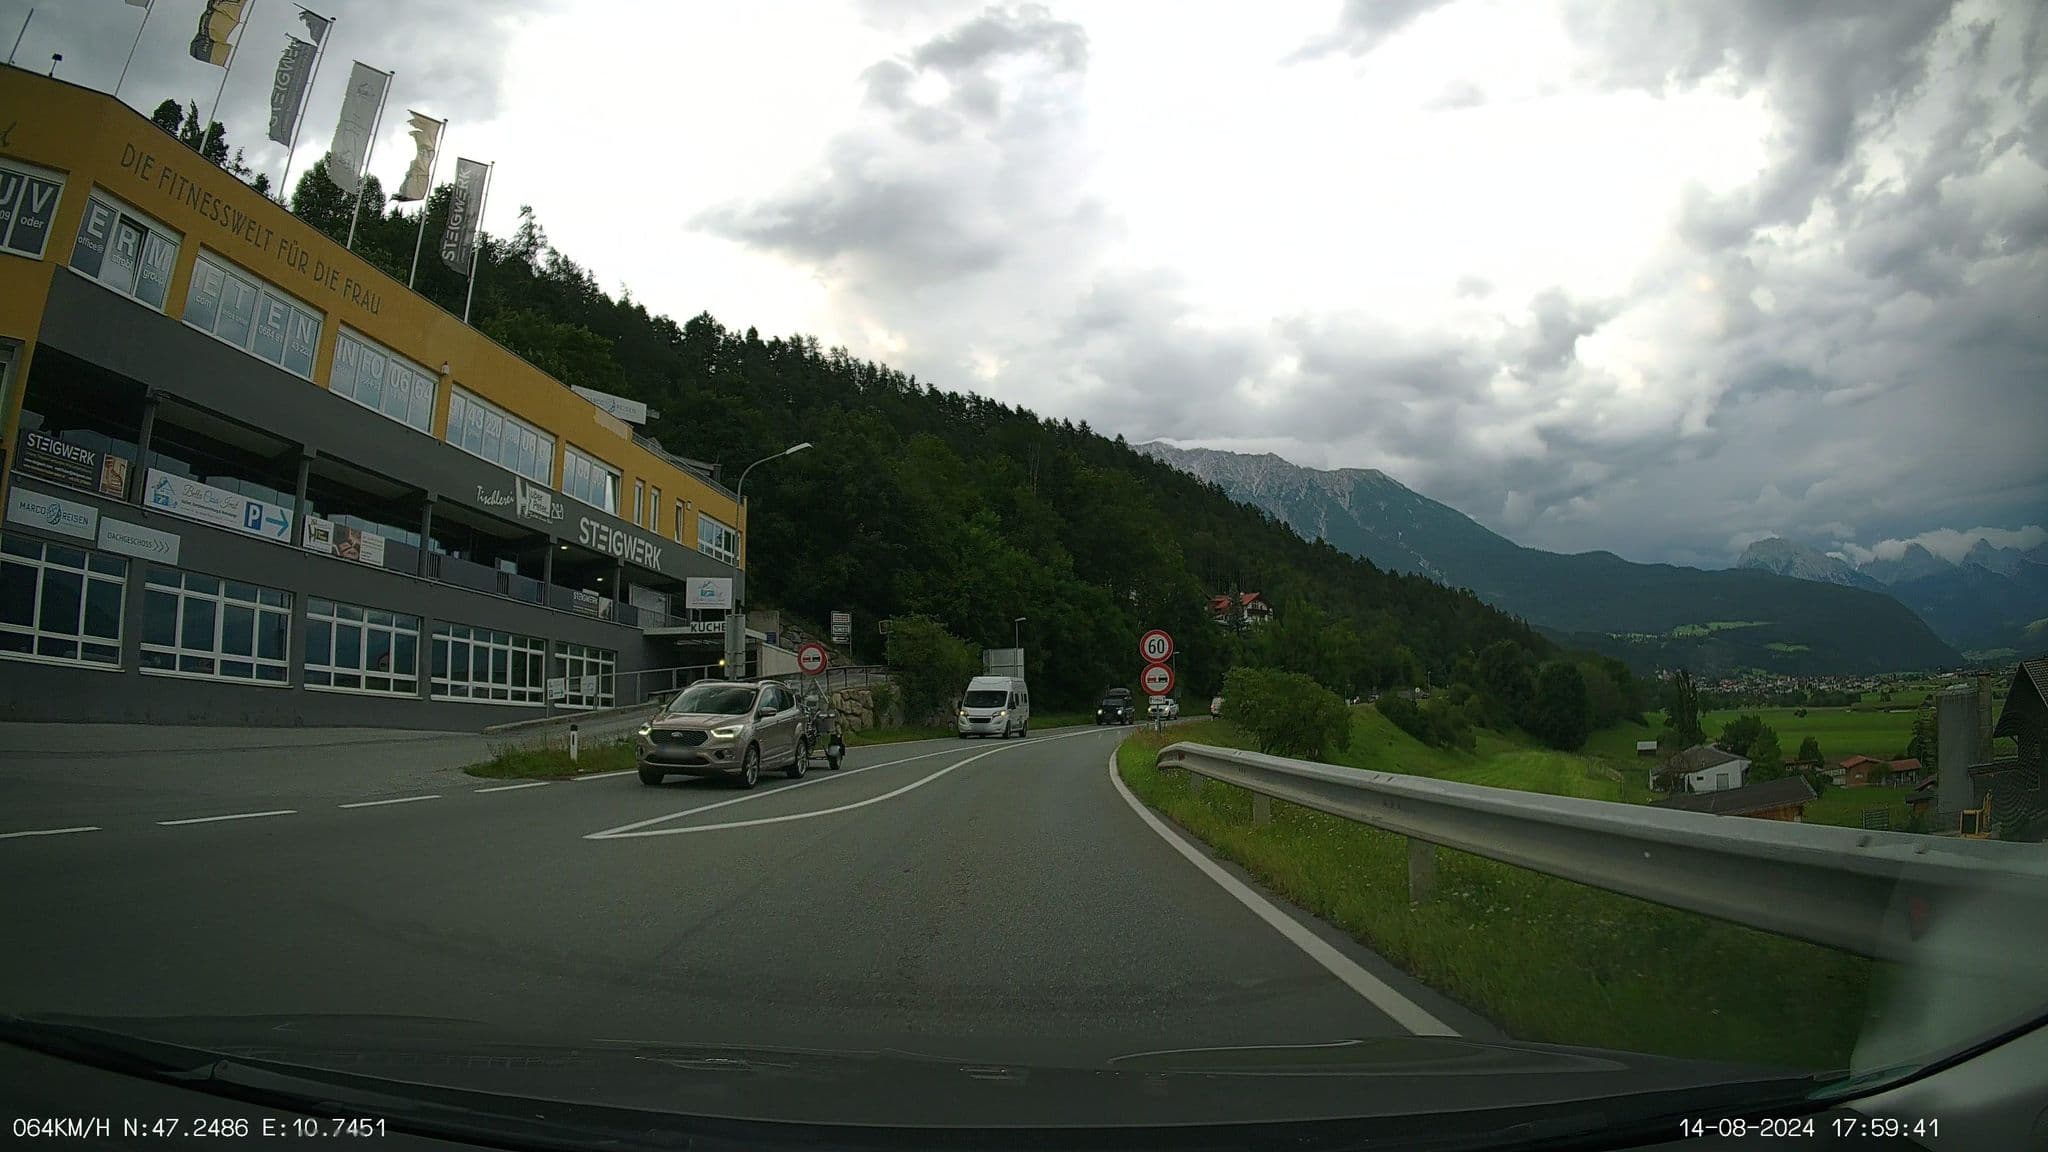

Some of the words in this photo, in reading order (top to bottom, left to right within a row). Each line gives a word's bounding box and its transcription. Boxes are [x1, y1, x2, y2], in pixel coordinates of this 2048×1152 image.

[20, 215, 44, 230] oder
[120, 142, 155, 181] DIE
[158, 166, 273, 251] FITNESSWELT
[277, 239, 309, 275] FÜR
[314, 260, 340, 291] DIE
[343, 278, 381, 314] FRAU
[441, 167, 472, 262] STEIGWERK
[27, 432, 96, 466] STEIGWERK
[19, 501, 46, 515] MARCO
[62, 513, 89, 526] REISEN
[107, 531, 154, 549] DACHGESCHOSS
[579, 516, 662, 571] STEIGWERK
[1148, 638, 1165, 655] 60
